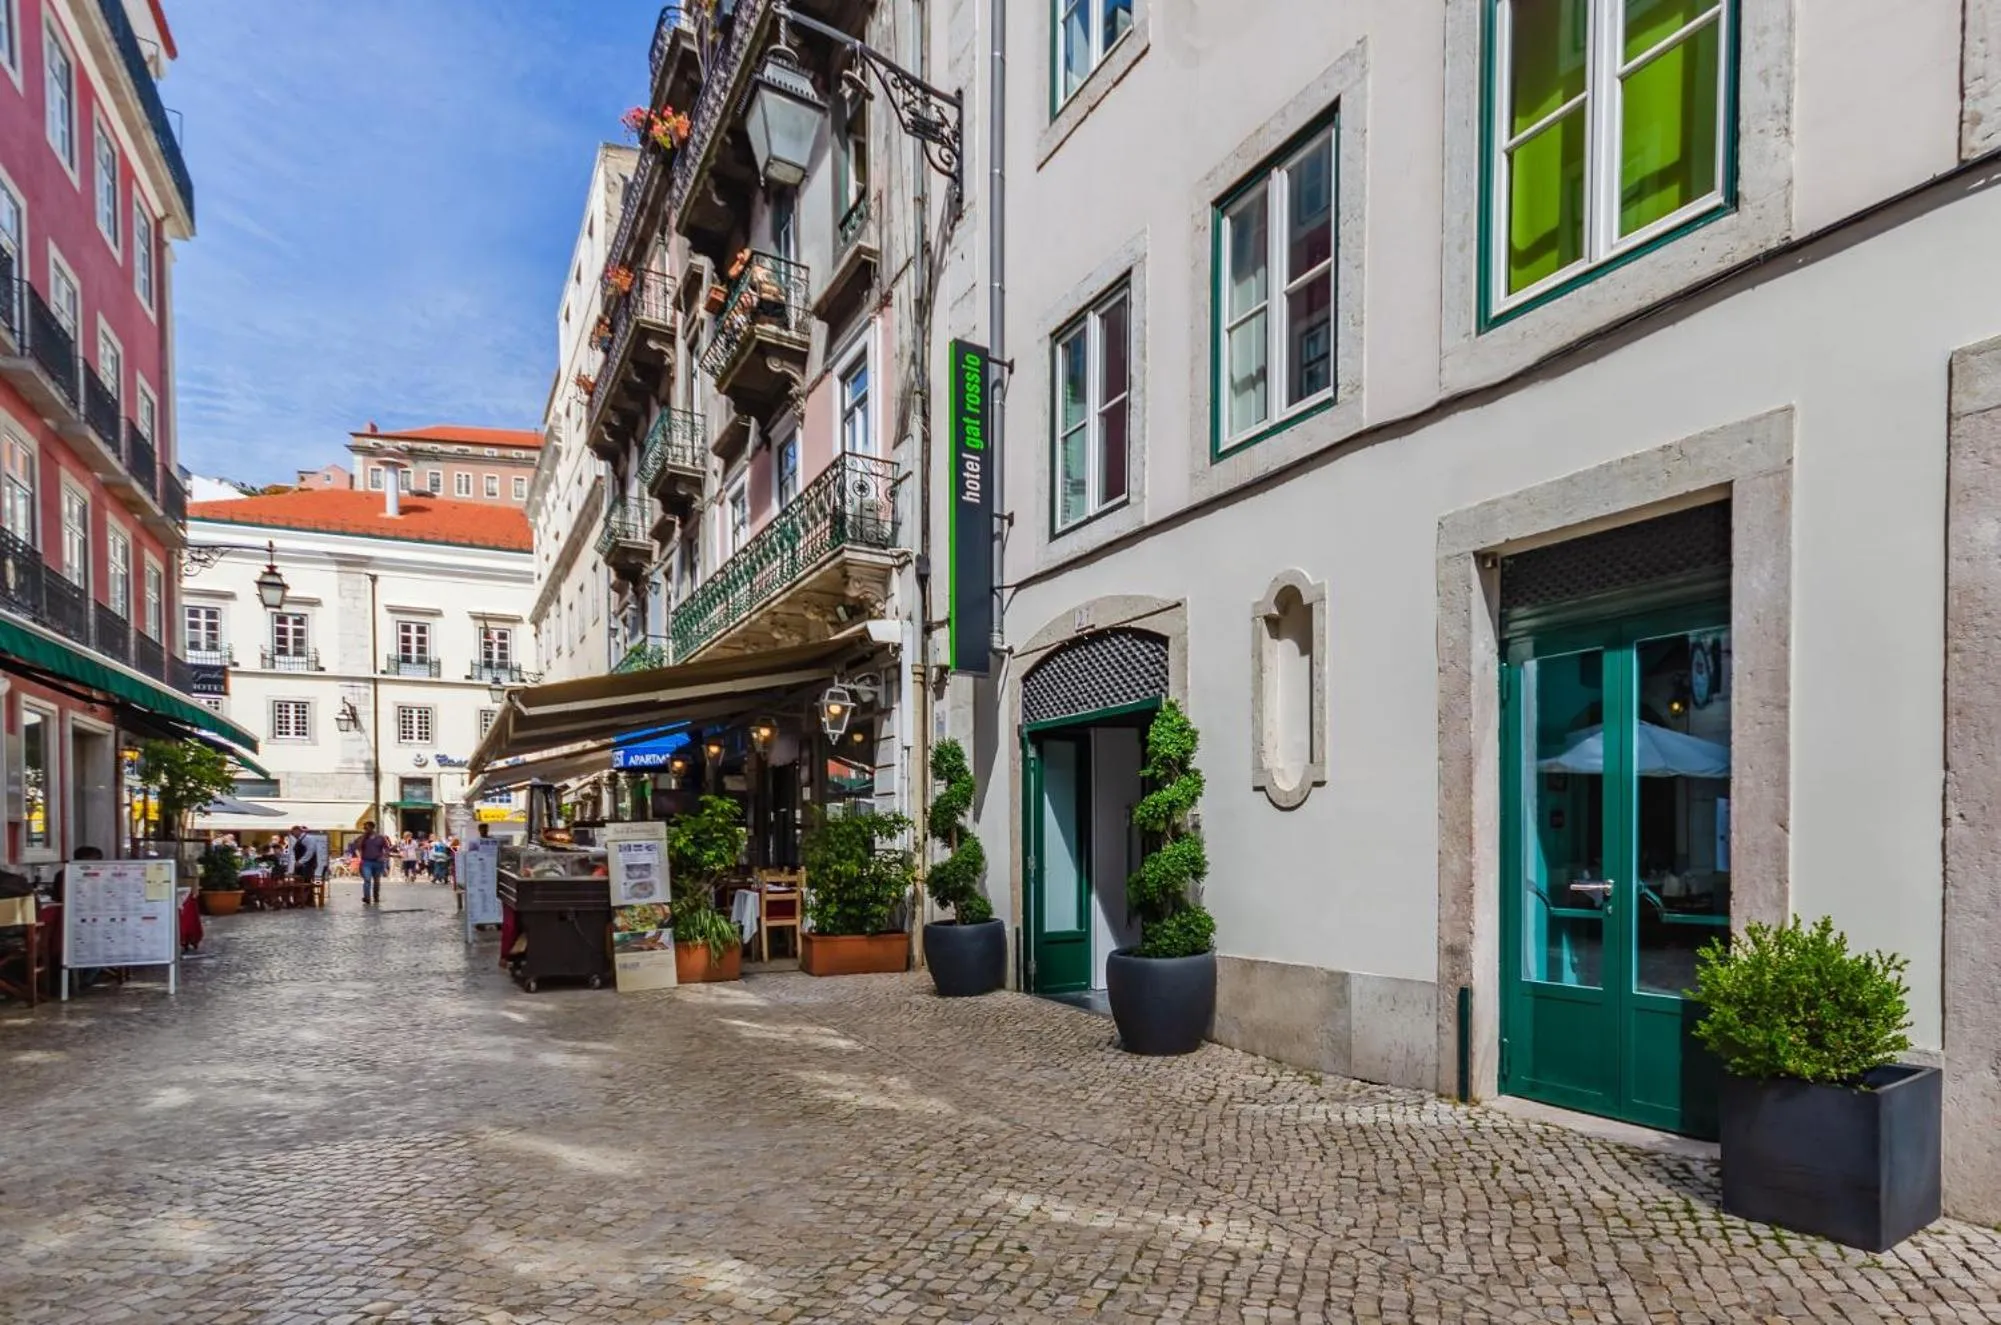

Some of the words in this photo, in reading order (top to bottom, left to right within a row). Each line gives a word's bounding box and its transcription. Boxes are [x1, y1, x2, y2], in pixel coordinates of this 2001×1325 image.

[961, 352, 981, 414] rossio
[962, 416, 984, 450] gat
[961, 452, 981, 503] hotel
